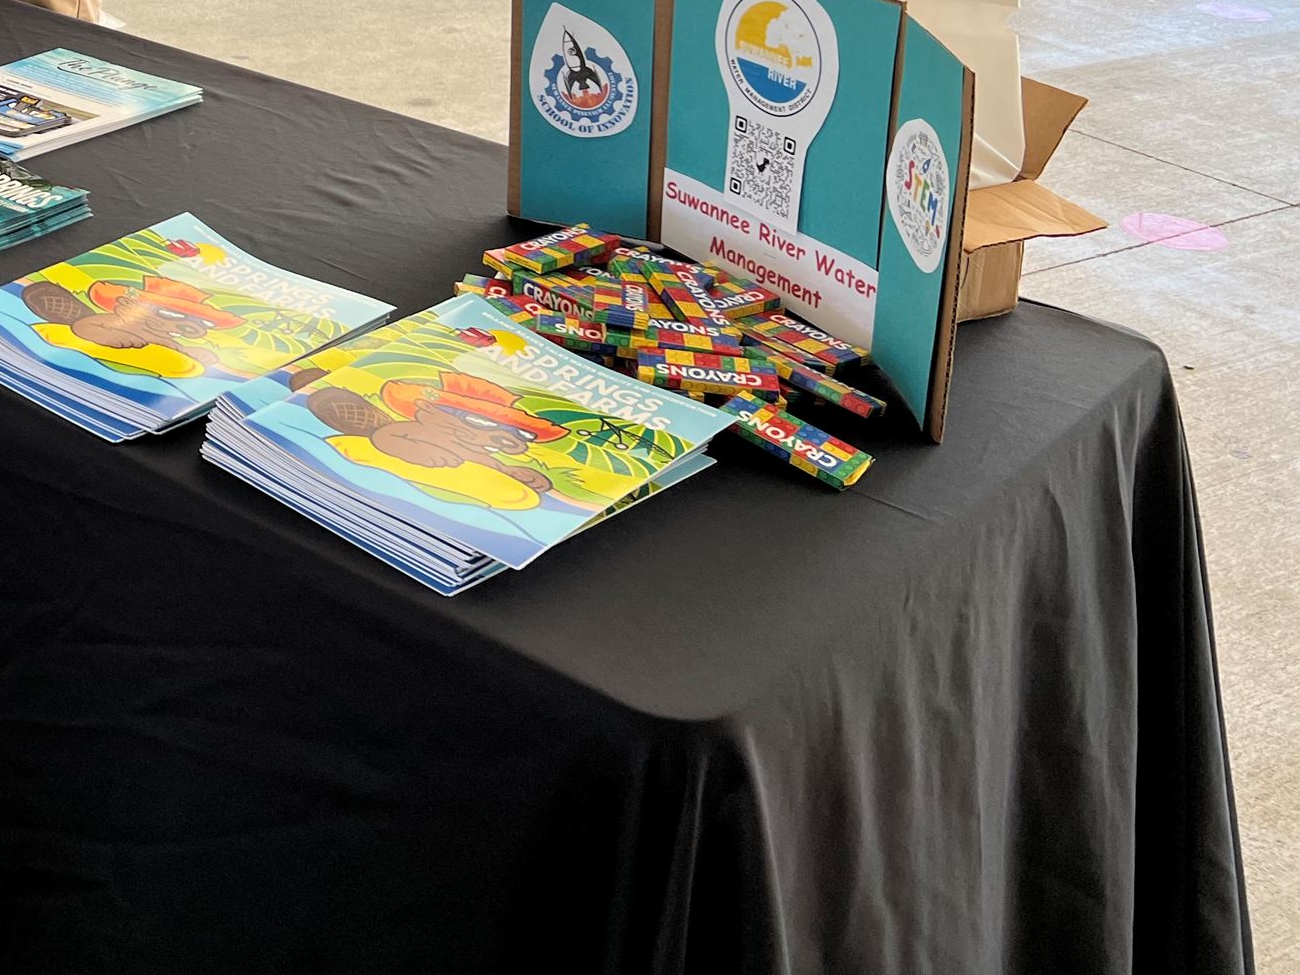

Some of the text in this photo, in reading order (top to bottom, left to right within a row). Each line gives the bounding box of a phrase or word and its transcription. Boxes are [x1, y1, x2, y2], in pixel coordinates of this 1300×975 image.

[59, 58, 92, 71] The
[730, 58, 744, 84] WATER
[789, 88, 812, 111] DISTRICT
[767, 69, 797, 90] RIVER
[538, 77, 635, 133] SCHOOL OF INNOVATION
[519, 225, 588, 251] CRAYONS
[666, 181, 876, 299] Suwannee River Water
[184, 256, 338, 319] AND FARMS
[216, 256, 336, 305] SPRINGS
[677, 271, 730, 326] CRAYONS
[709, 236, 822, 309] Management
[769, 313, 852, 351] CRAYONS
[481, 344, 672, 431] AND FARMS
[515, 345, 664, 412] SPRINGS
[655, 363, 762, 386] CRAYONS
[736, 410, 838, 468] CRAYONS
